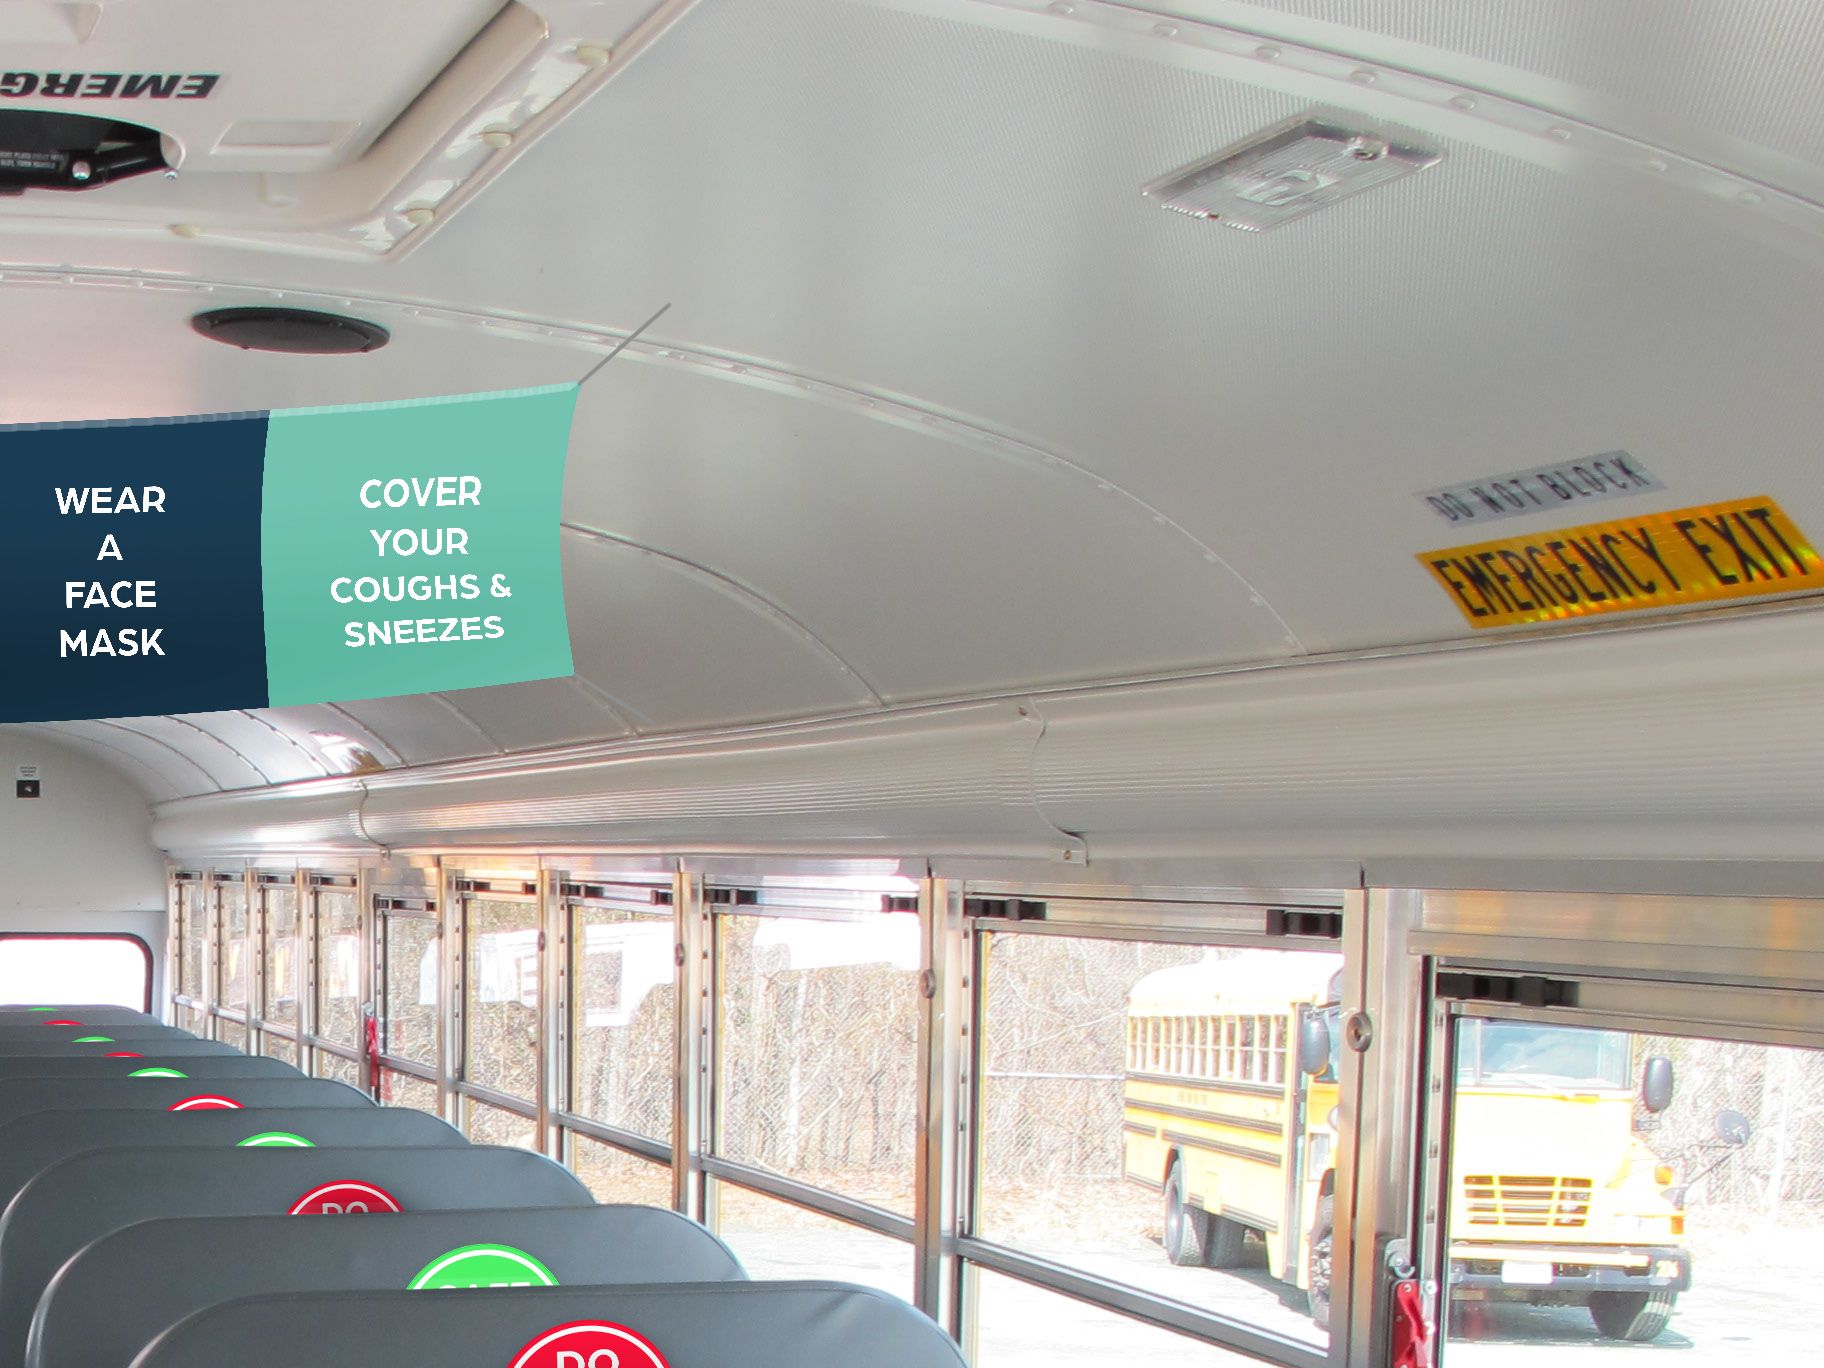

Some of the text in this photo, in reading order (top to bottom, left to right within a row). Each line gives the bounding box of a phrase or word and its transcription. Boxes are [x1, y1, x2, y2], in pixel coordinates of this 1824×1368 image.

[55, 485, 166, 515] WEAR
[359, 475, 482, 509] COVER
[1427, 456, 1651, 521] DO NOT BLOCK
[96, 533, 124, 561] A
[369, 527, 470, 557] YOUR
[1431, 506, 1810, 618] EMERGENCY EXIT
[65, 580, 157, 609] FACE
[330, 573, 513, 604] COUGHS &
[60, 628, 166, 658] MASK
[344, 615, 505, 648] SNEEZES
